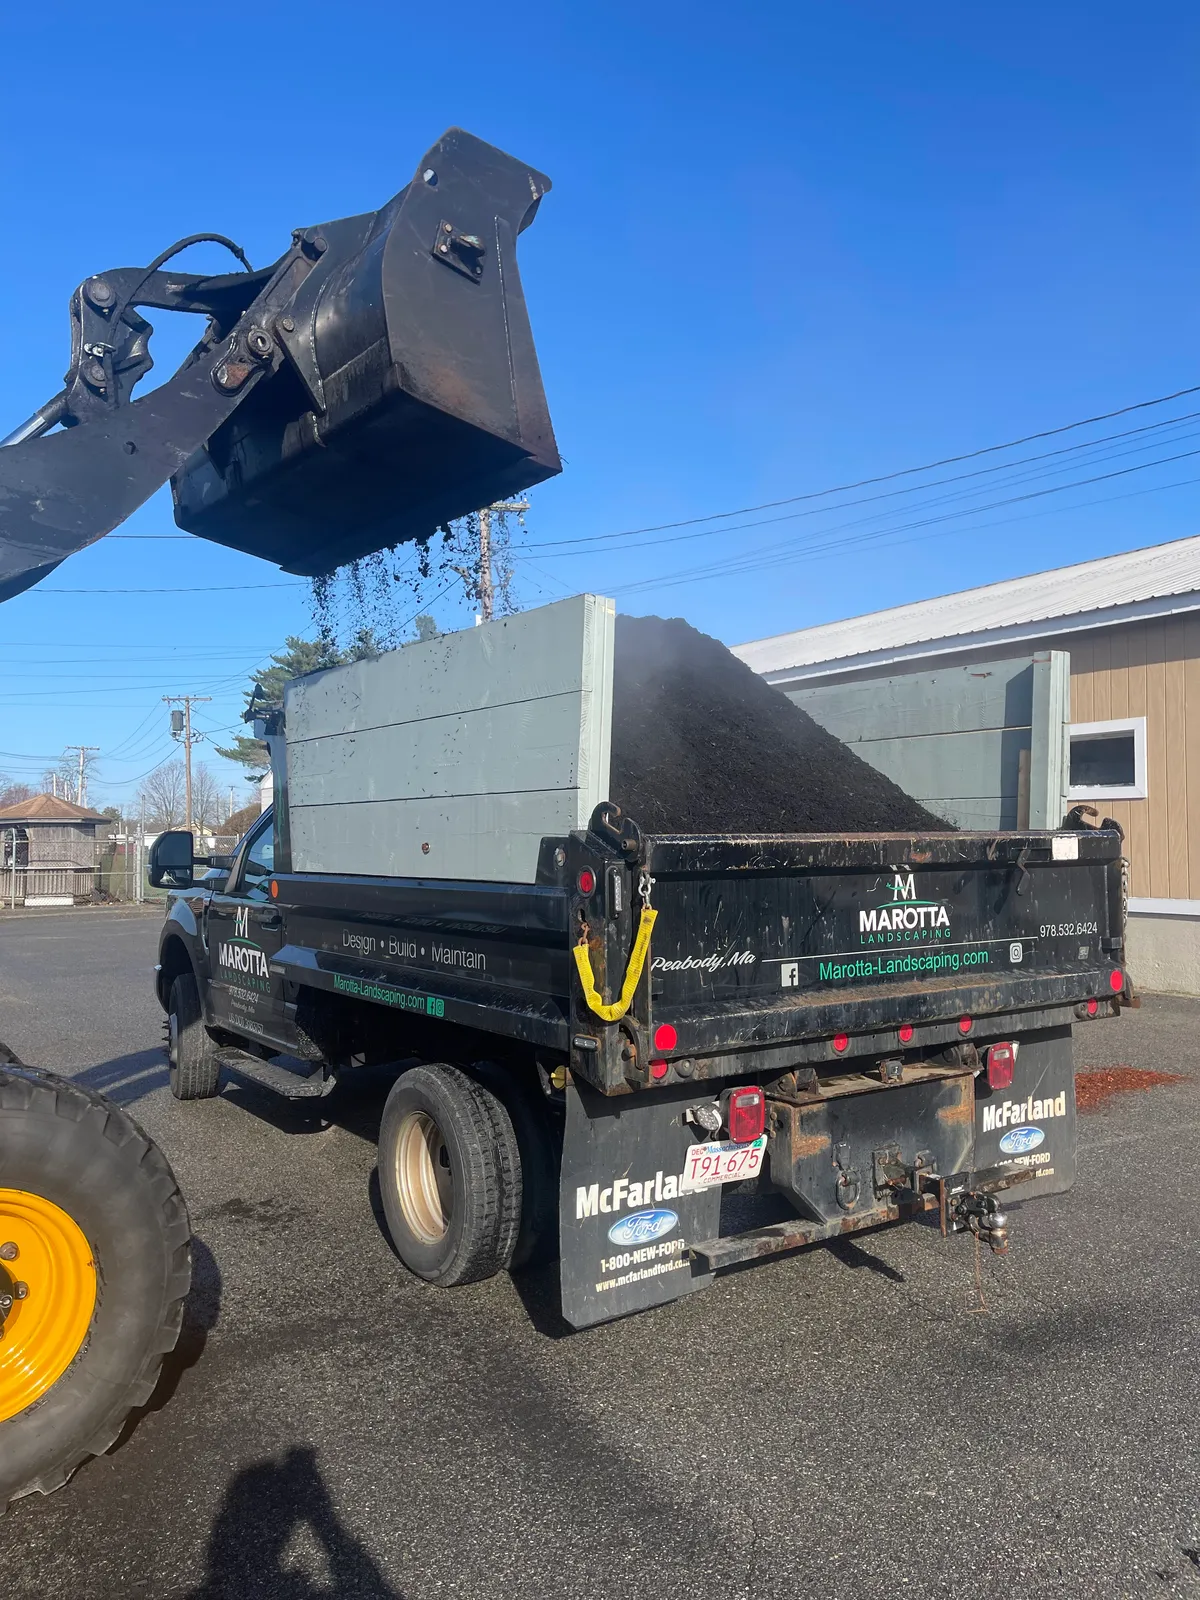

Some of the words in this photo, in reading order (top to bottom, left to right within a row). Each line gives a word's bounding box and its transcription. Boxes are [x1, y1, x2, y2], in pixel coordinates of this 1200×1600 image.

[859, 905, 951, 933] MAROTTA
[1039, 921, 1098, 938] 978.532.6424
[342, 928, 376, 955] Design
[388, 935, 417, 959] Build
[431, 941, 486, 970] Maintain
[860, 928, 952, 944] LANDSCAPING
[218, 942, 270, 979] MAROTTA
[819, 950, 989, 981] Marotta-Landscaping.com
[220, 969, 271, 993] LANDSCAPING
[334, 974, 425, 1009] Marotta-Landscaping.com
[983, 1090, 1066, 1132] McFarland
[703, 1172, 741, 1184] COMMERCIAL
[576, 1171, 709, 1220] McFarla
[623, 1212, 664, 1240] Ford
